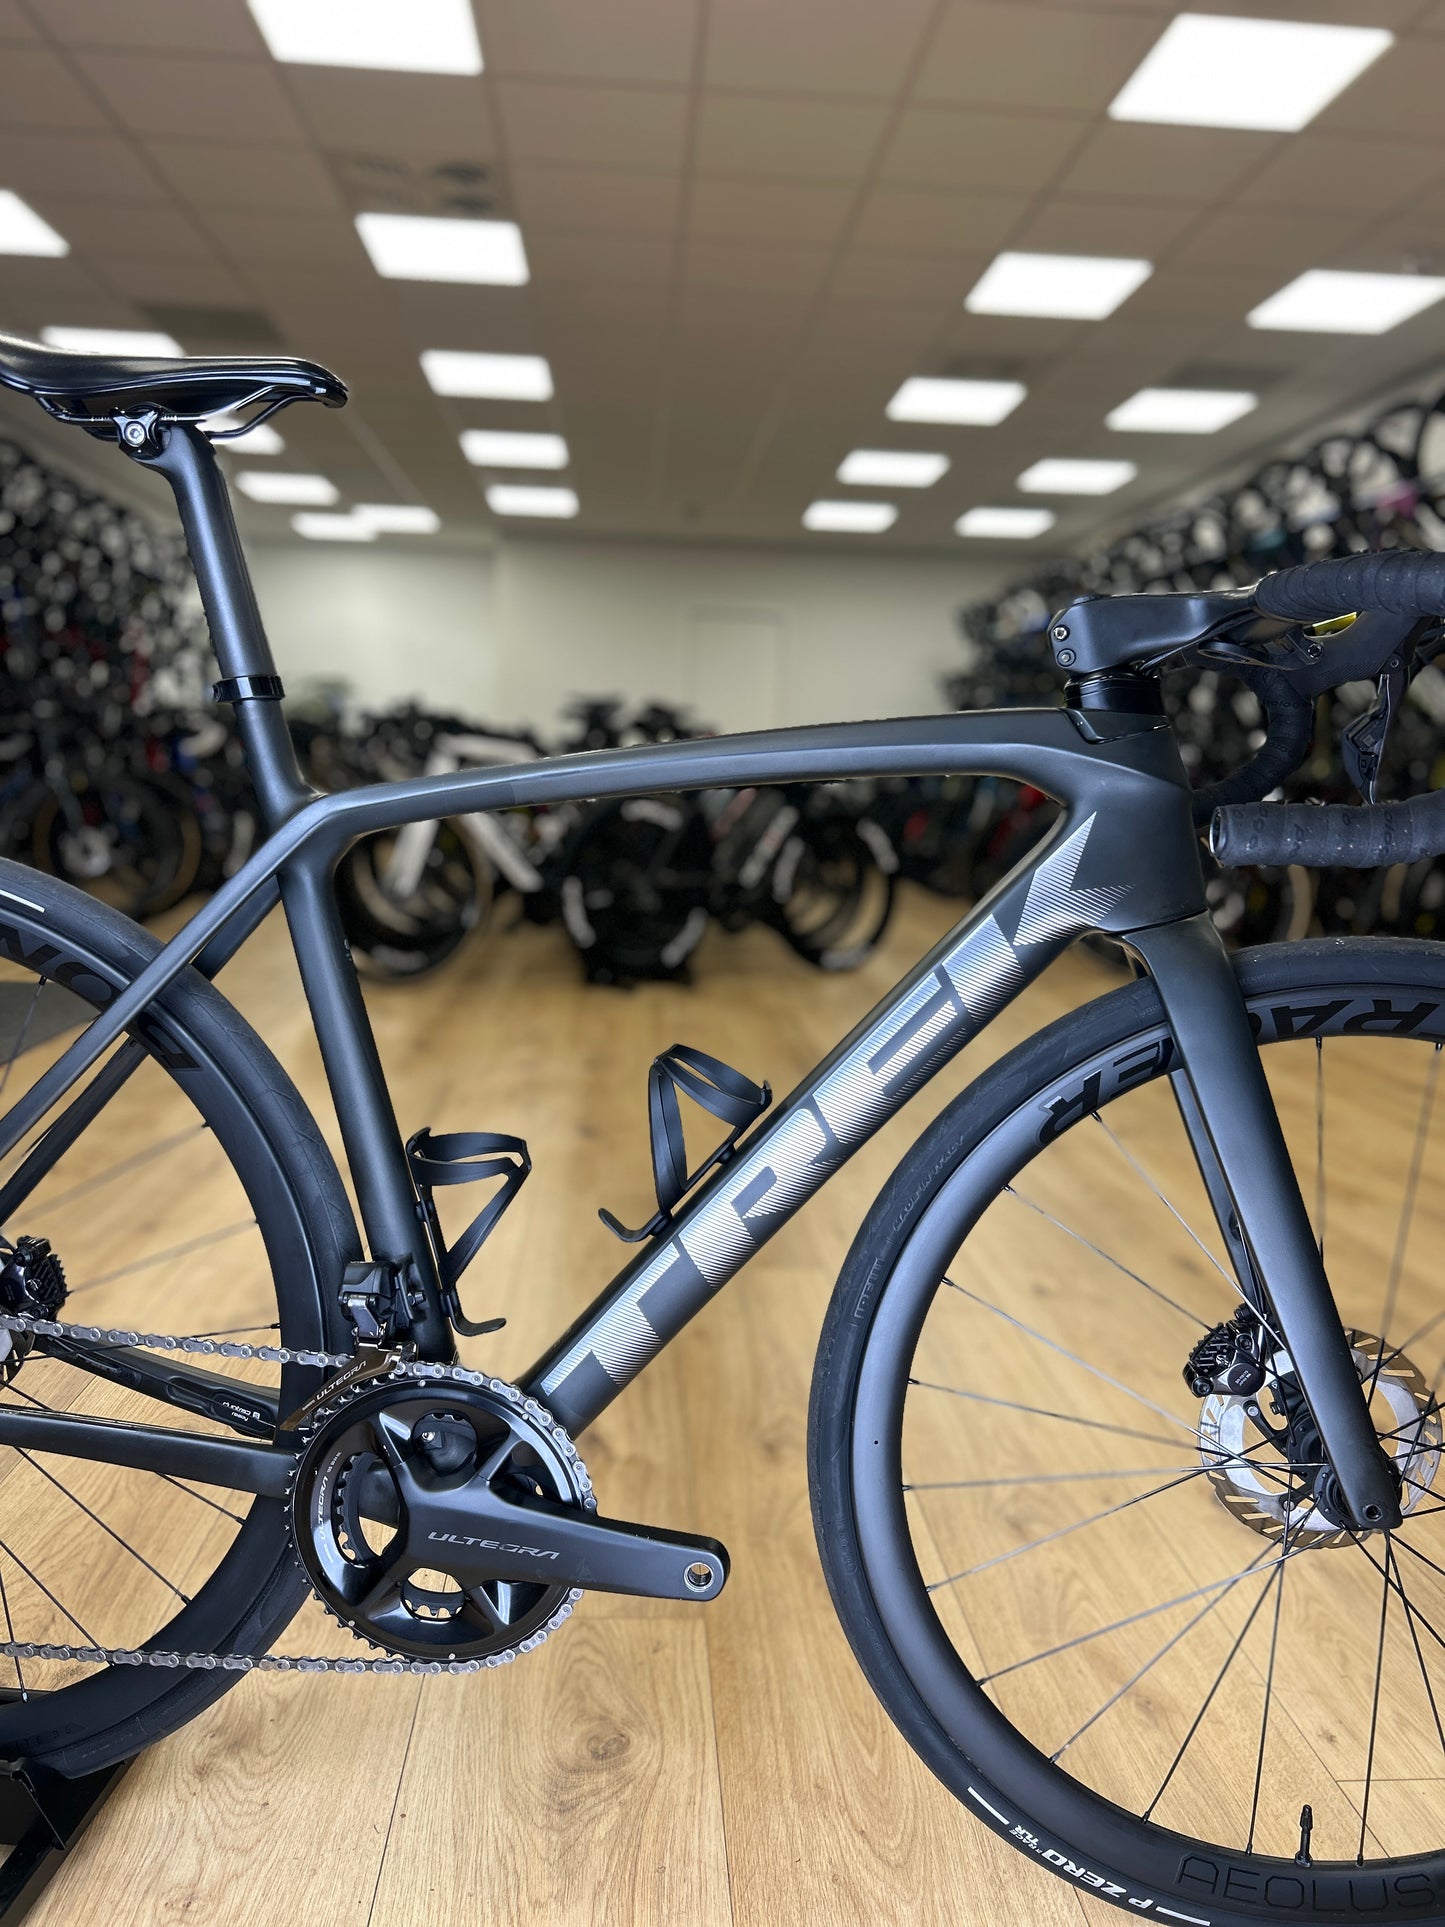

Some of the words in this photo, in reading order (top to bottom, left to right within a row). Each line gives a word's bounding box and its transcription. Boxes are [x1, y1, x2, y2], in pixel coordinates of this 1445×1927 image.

[541, 812, 1134, 1396] TREK
[316, 1360, 367, 1401] ULTEGRA
[316, 1475, 329, 1541] ULTEGRA
[427, 1531, 560, 1560] ULTEGRA
[1041, 1848, 1127, 1898] ZERO
[1177, 1854, 1431, 1913] AEOLUS
[1128, 1897, 1154, 1909] P
